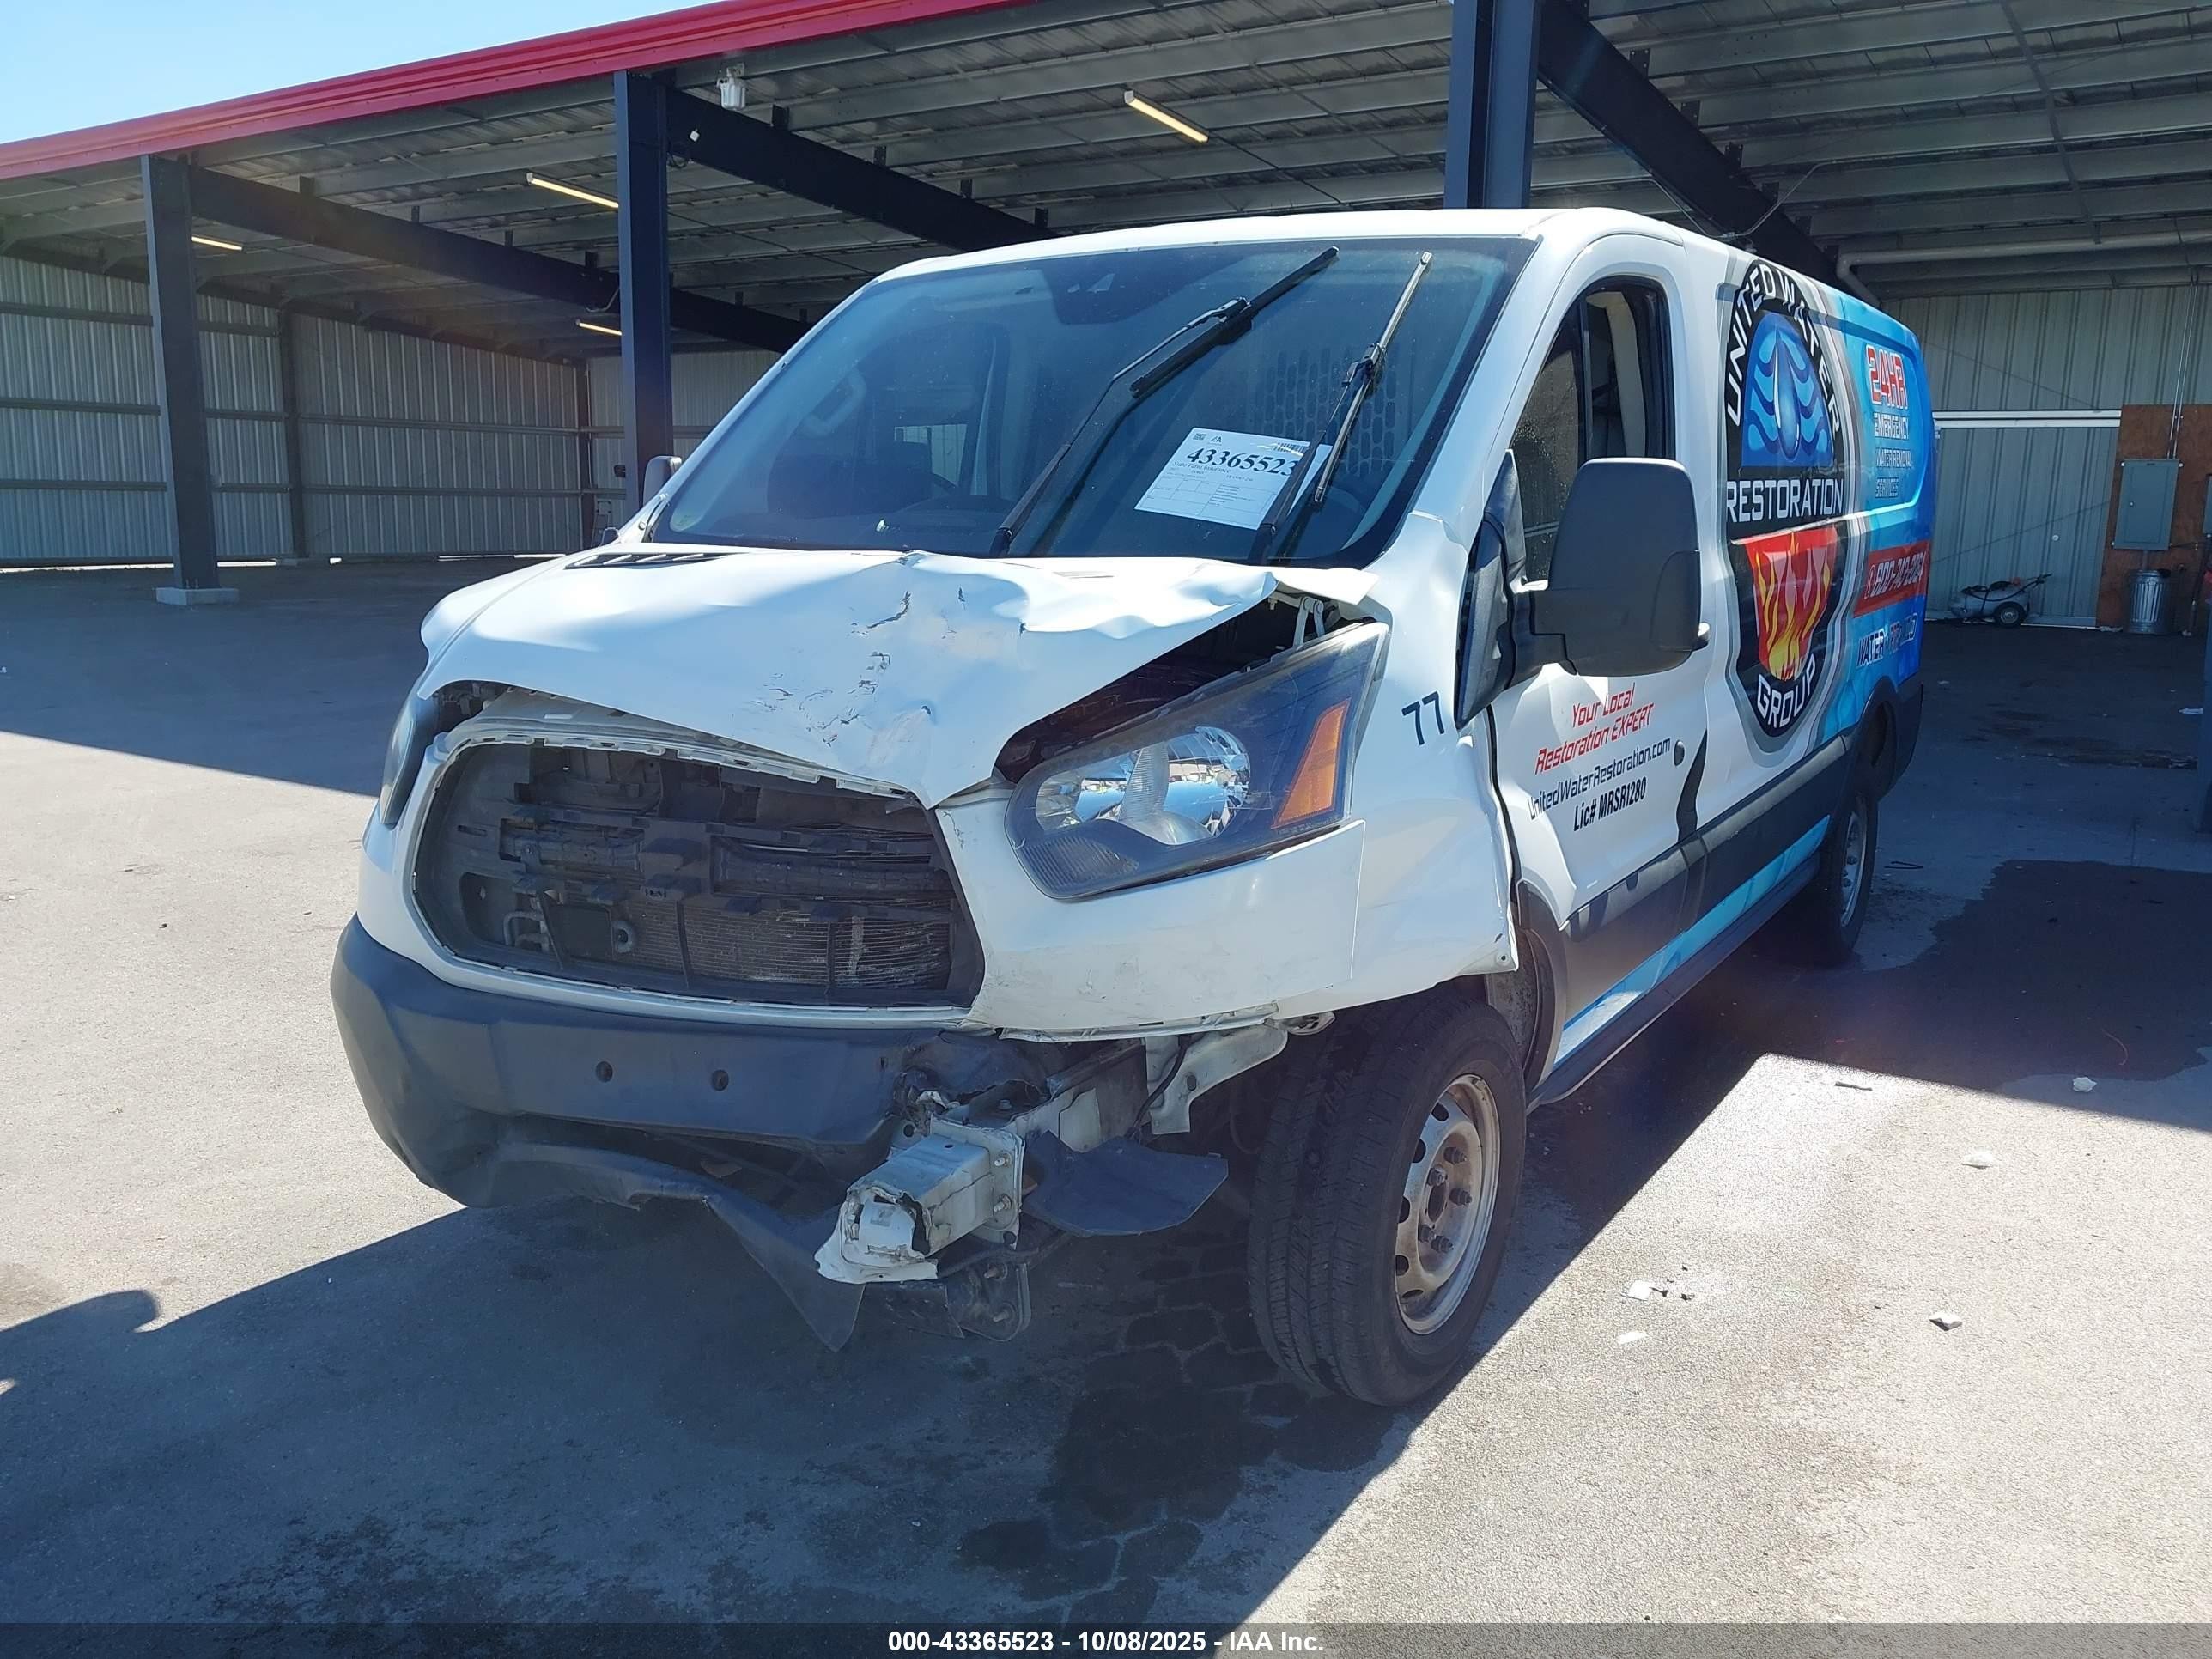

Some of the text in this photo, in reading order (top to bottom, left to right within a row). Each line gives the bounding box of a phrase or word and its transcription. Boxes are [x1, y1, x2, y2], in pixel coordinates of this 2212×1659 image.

[1728, 264, 1841, 437] UNITED WATER
[1874, 414, 1909, 440] EMERGENCY
[1187, 447, 1298, 476] 43365523
[1726, 478, 1844, 523] RESTORATION
[1401, 691, 1445, 745] 77
[1572, 682, 1635, 727] Your Local
[1757, 653, 1815, 729] GROUP
[1534, 702, 1654, 775] Restoration EXPERT
[1528, 738, 1670, 820] UnitedWaterRestoration.com
[1574, 776, 1646, 831] Lic# MRSR1280
